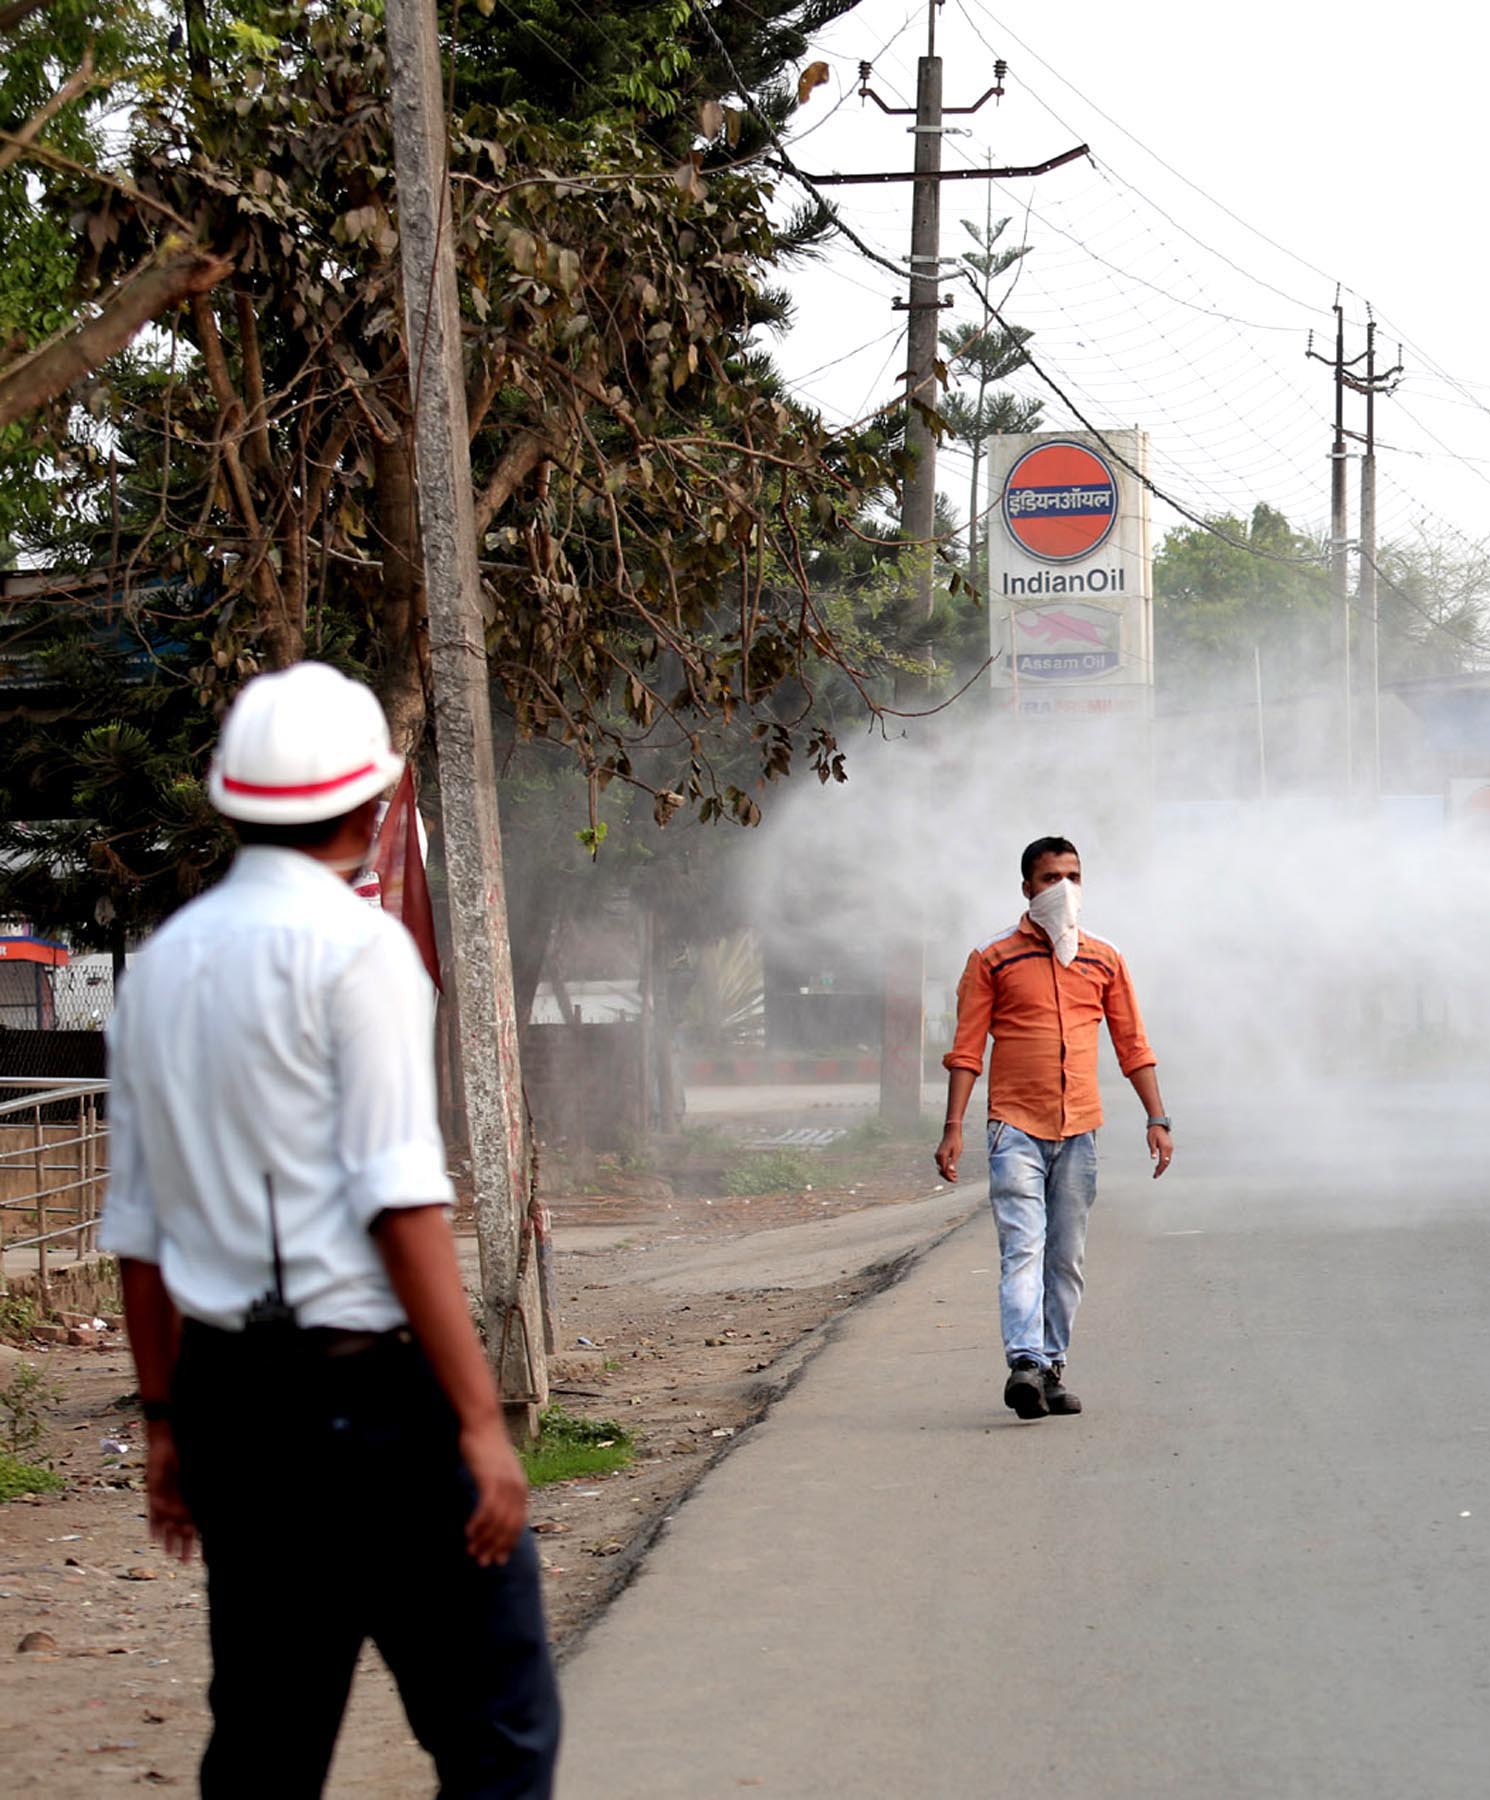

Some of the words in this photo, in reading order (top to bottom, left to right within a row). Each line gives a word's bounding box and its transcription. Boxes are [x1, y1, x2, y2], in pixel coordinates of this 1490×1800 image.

[1009, 487, 1111, 516] इंडियनऑयल
[1003, 568, 1125, 595] IndianOil
[1020, 656, 1079, 671] Assam
[1082, 654, 1105, 669] Oil
